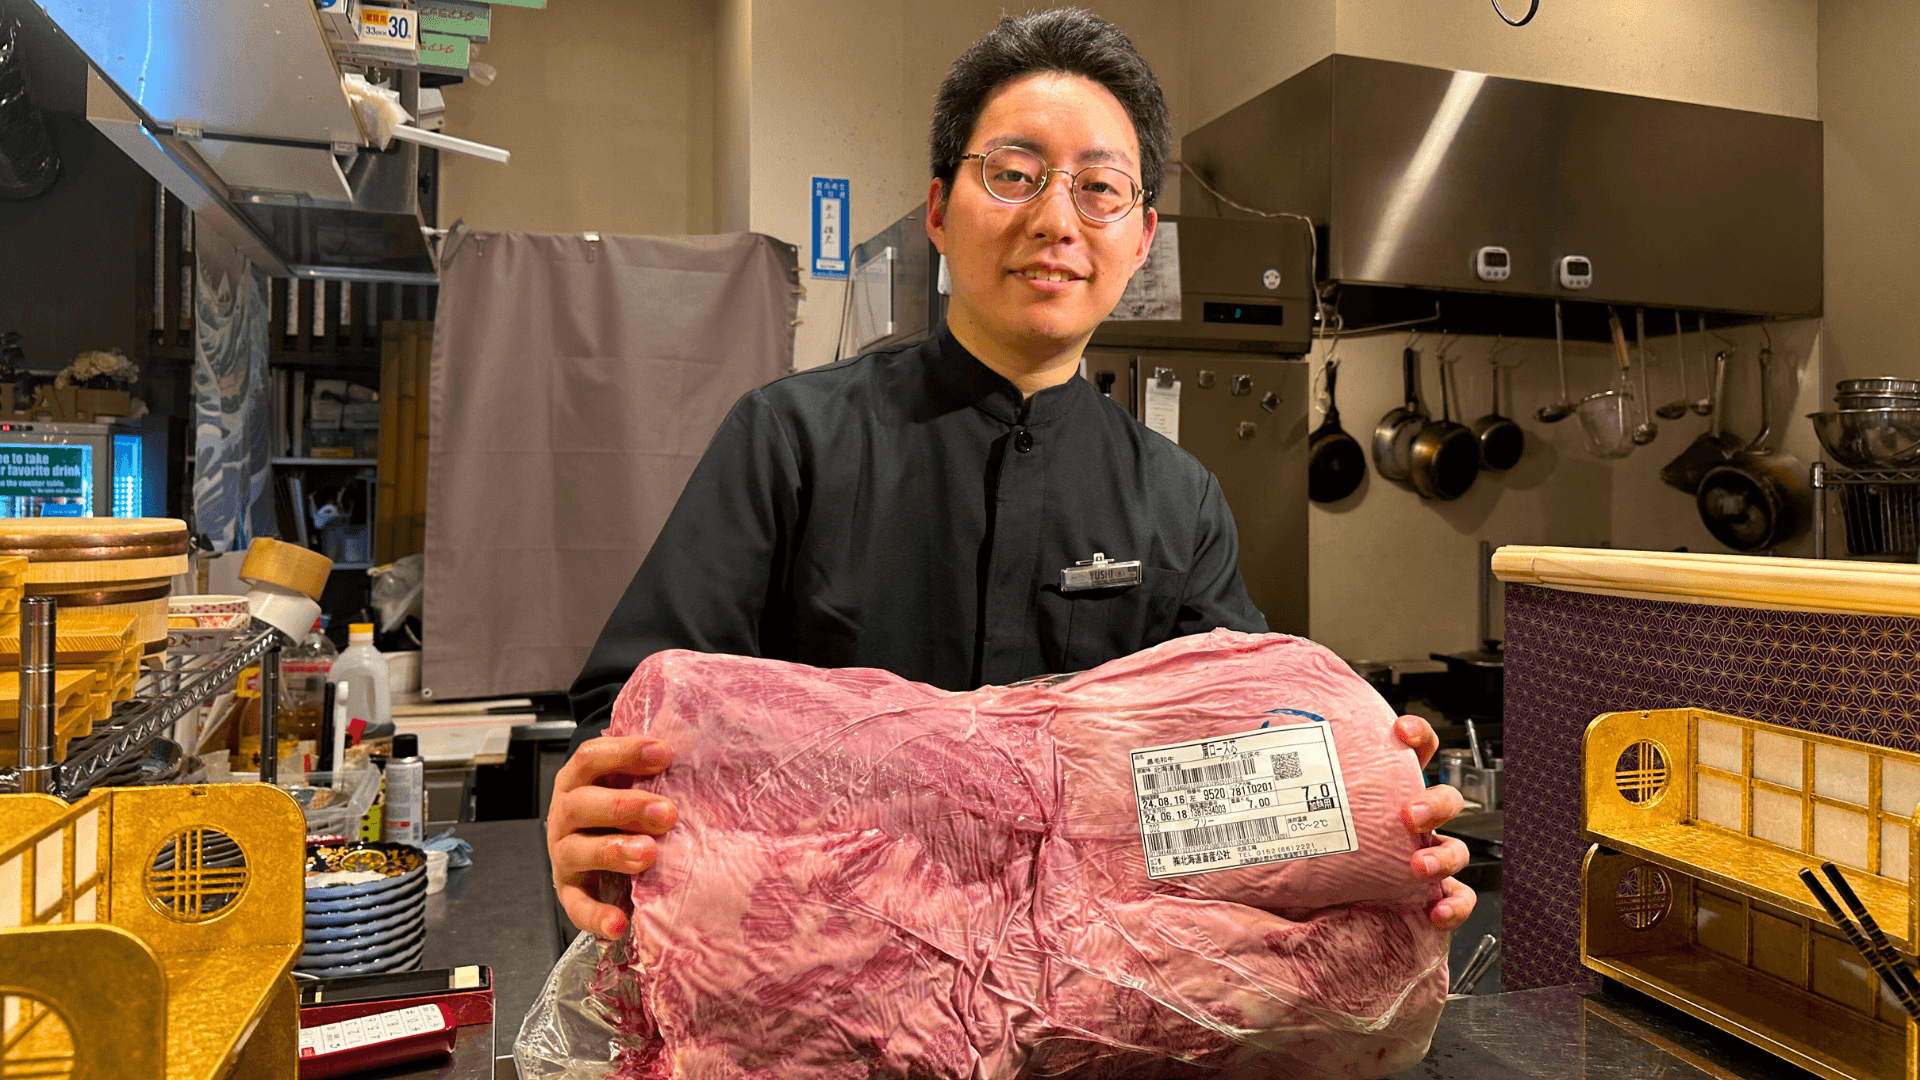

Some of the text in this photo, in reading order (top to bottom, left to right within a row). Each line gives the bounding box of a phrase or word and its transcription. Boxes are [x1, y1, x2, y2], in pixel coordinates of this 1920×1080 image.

[12, 453, 23, 464] to
[25, 453, 49, 464] take
[8, 464, 50, 476] favorite
[52, 464, 81, 476] drink
[1090, 569, 1113, 580] YUSHI
[1203, 787, 1226, 801] 9520
[1231, 782, 1273, 796] 78110201
[1301, 783, 1330, 801] 7.0
[1142, 795, 1186, 809] 24.08.16
[1249, 797, 1271, 809] 7.00
[1145, 810, 1188, 824] 24.06.18
